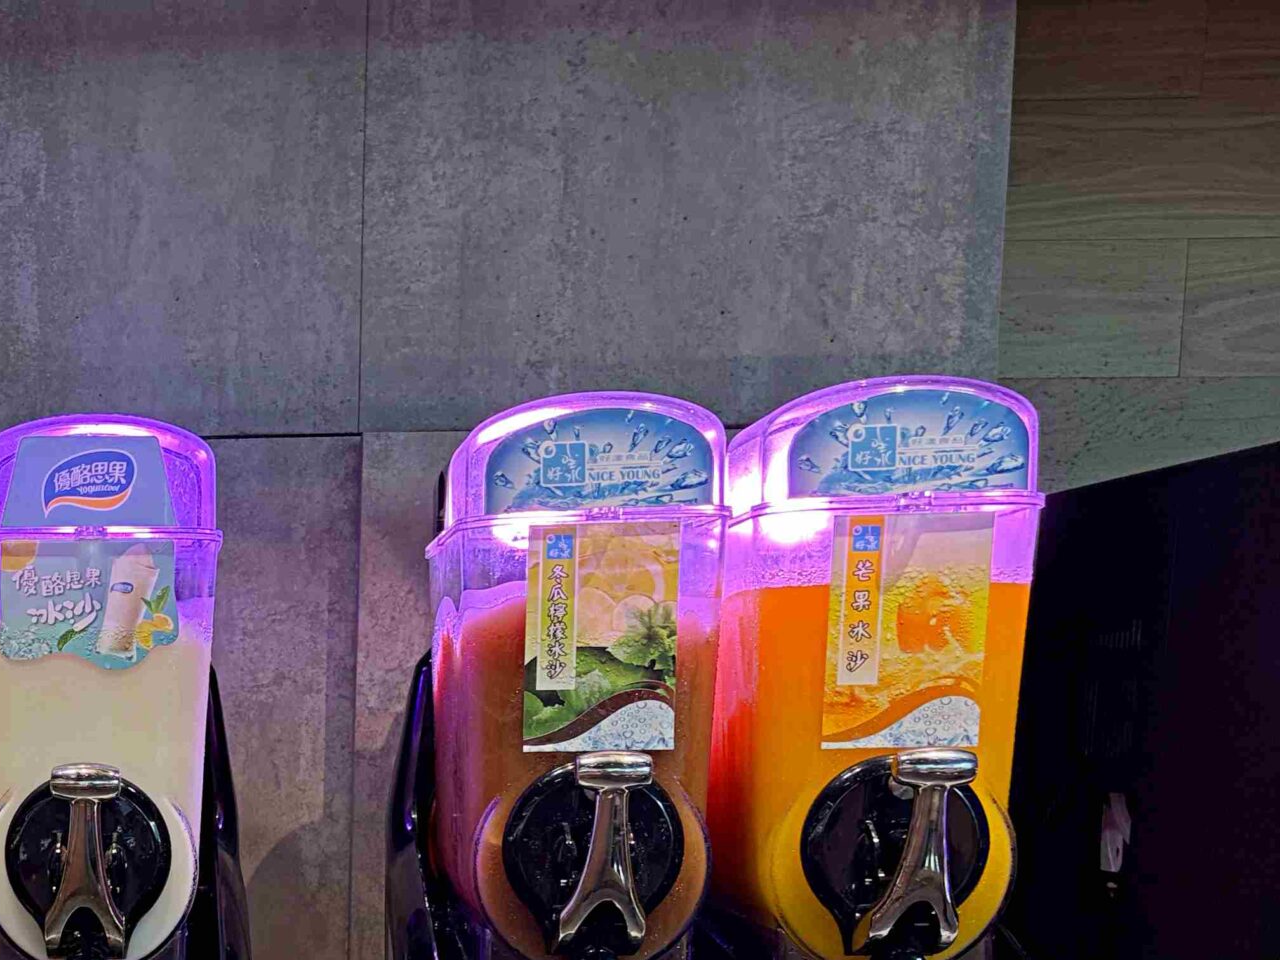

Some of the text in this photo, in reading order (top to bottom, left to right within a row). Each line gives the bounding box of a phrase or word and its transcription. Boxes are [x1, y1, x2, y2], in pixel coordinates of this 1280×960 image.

[588, 469, 661, 482] NICE YOUNG
[898, 453, 977, 466] NICE YOUNG
[53, 461, 127, 493] 優酪思果
[12, 565, 101, 597] 優酪思果
[27, 593, 101, 632] 冰沙
[546, 564, 569, 680] 冬瓜檸檬冰沙
[846, 559, 875, 673] 芒果冰沙
